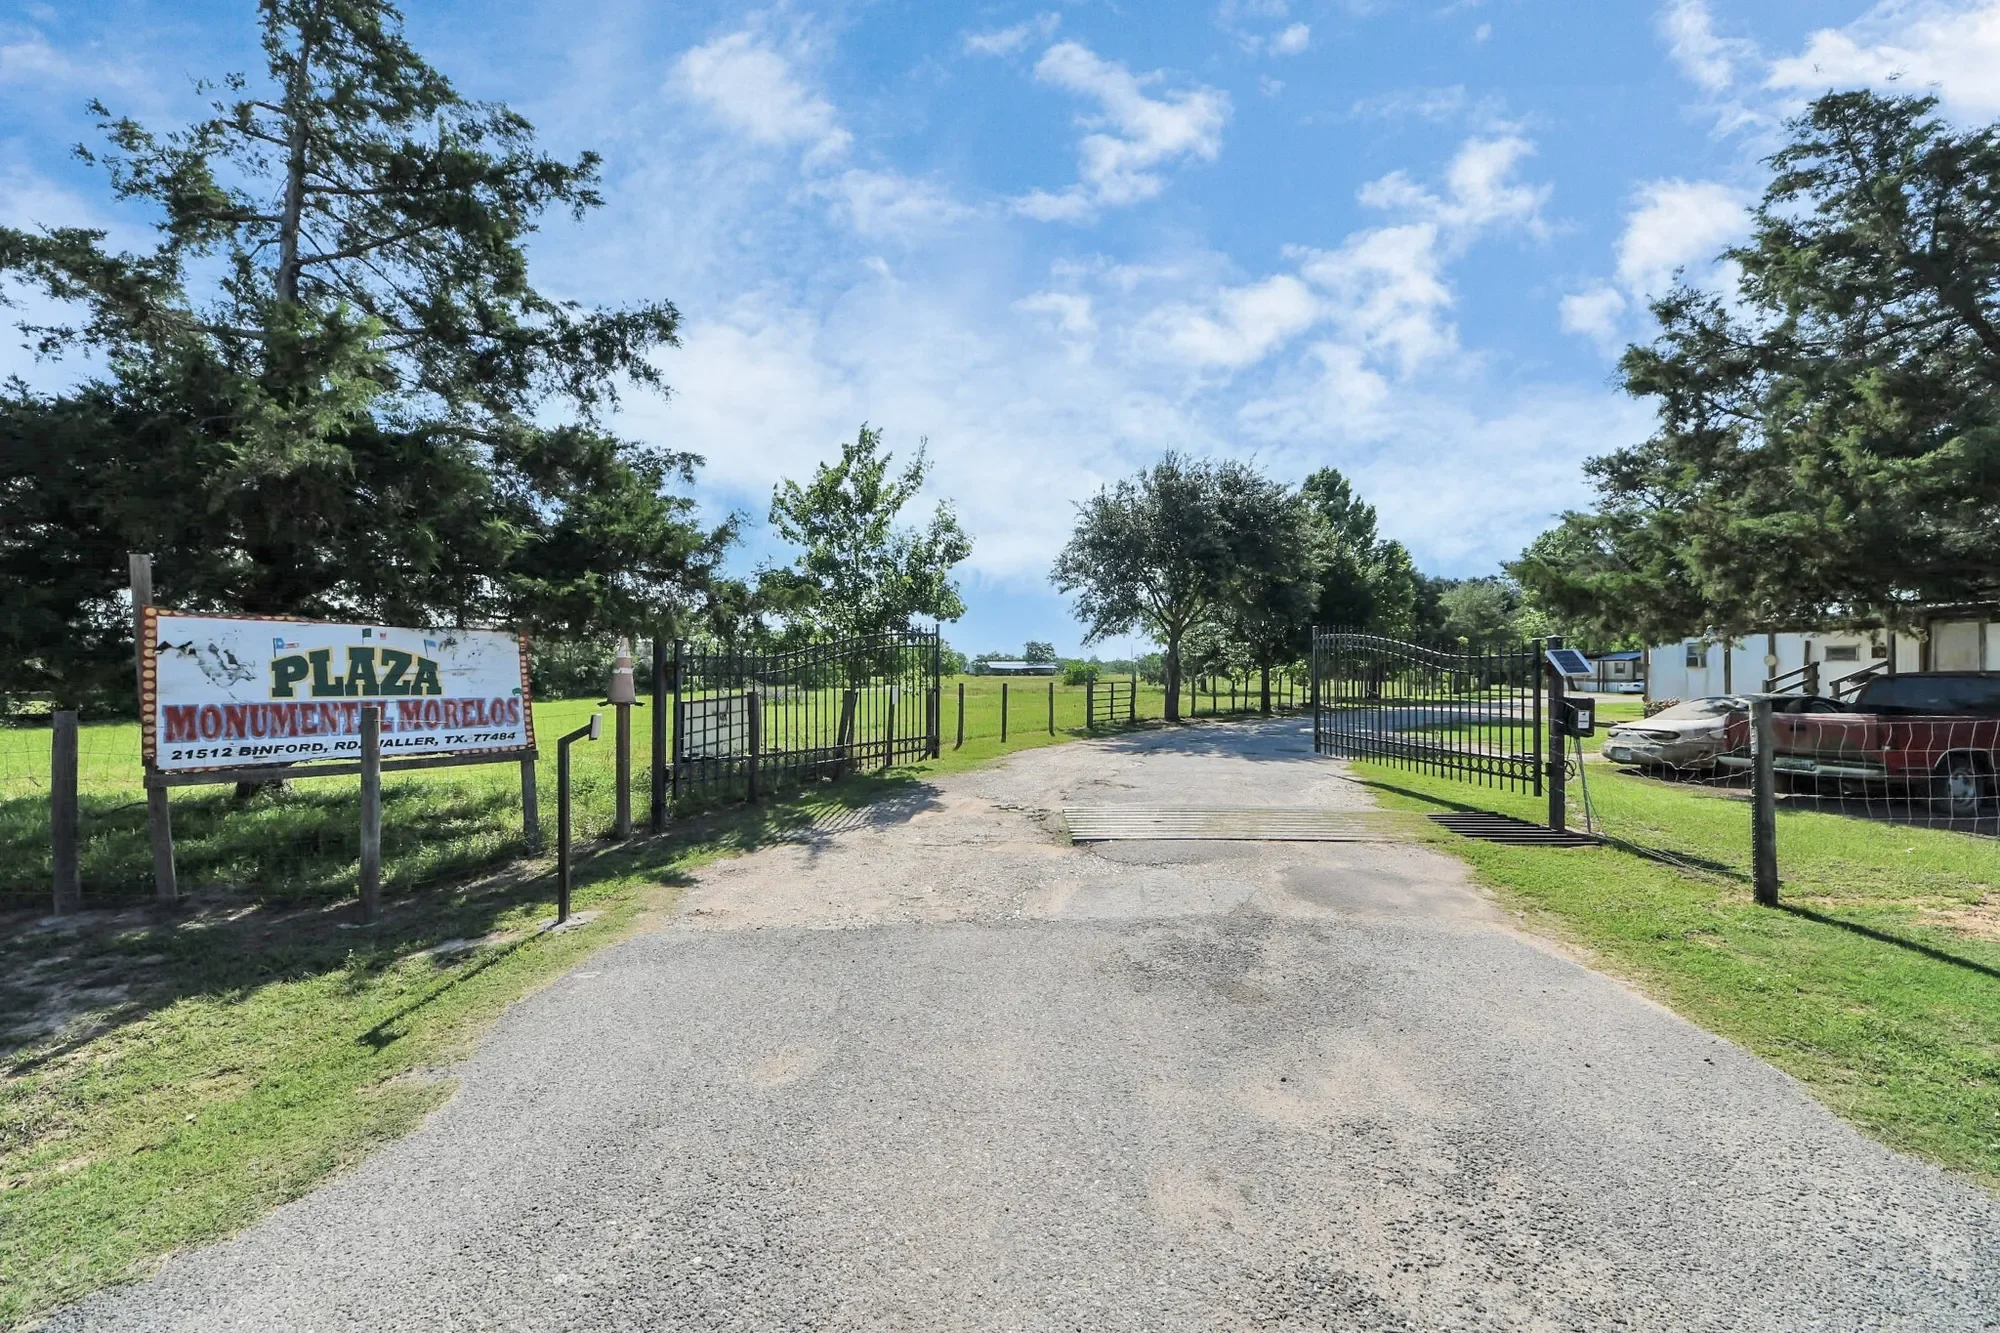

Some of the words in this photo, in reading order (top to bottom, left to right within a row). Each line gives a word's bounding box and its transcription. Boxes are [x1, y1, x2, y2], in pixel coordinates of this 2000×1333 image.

[270, 646, 443, 699] PLAZA
[163, 700, 394, 743] MONUMENTL
[397, 697, 521, 732] MORELOS
[171, 747, 233, 760] 21512
[238, 742, 329, 757] BINFORD,
[379, 736, 439, 748] ALLER,
[444, 734, 469, 745] TX.
[473, 731, 517, 742] 77484
